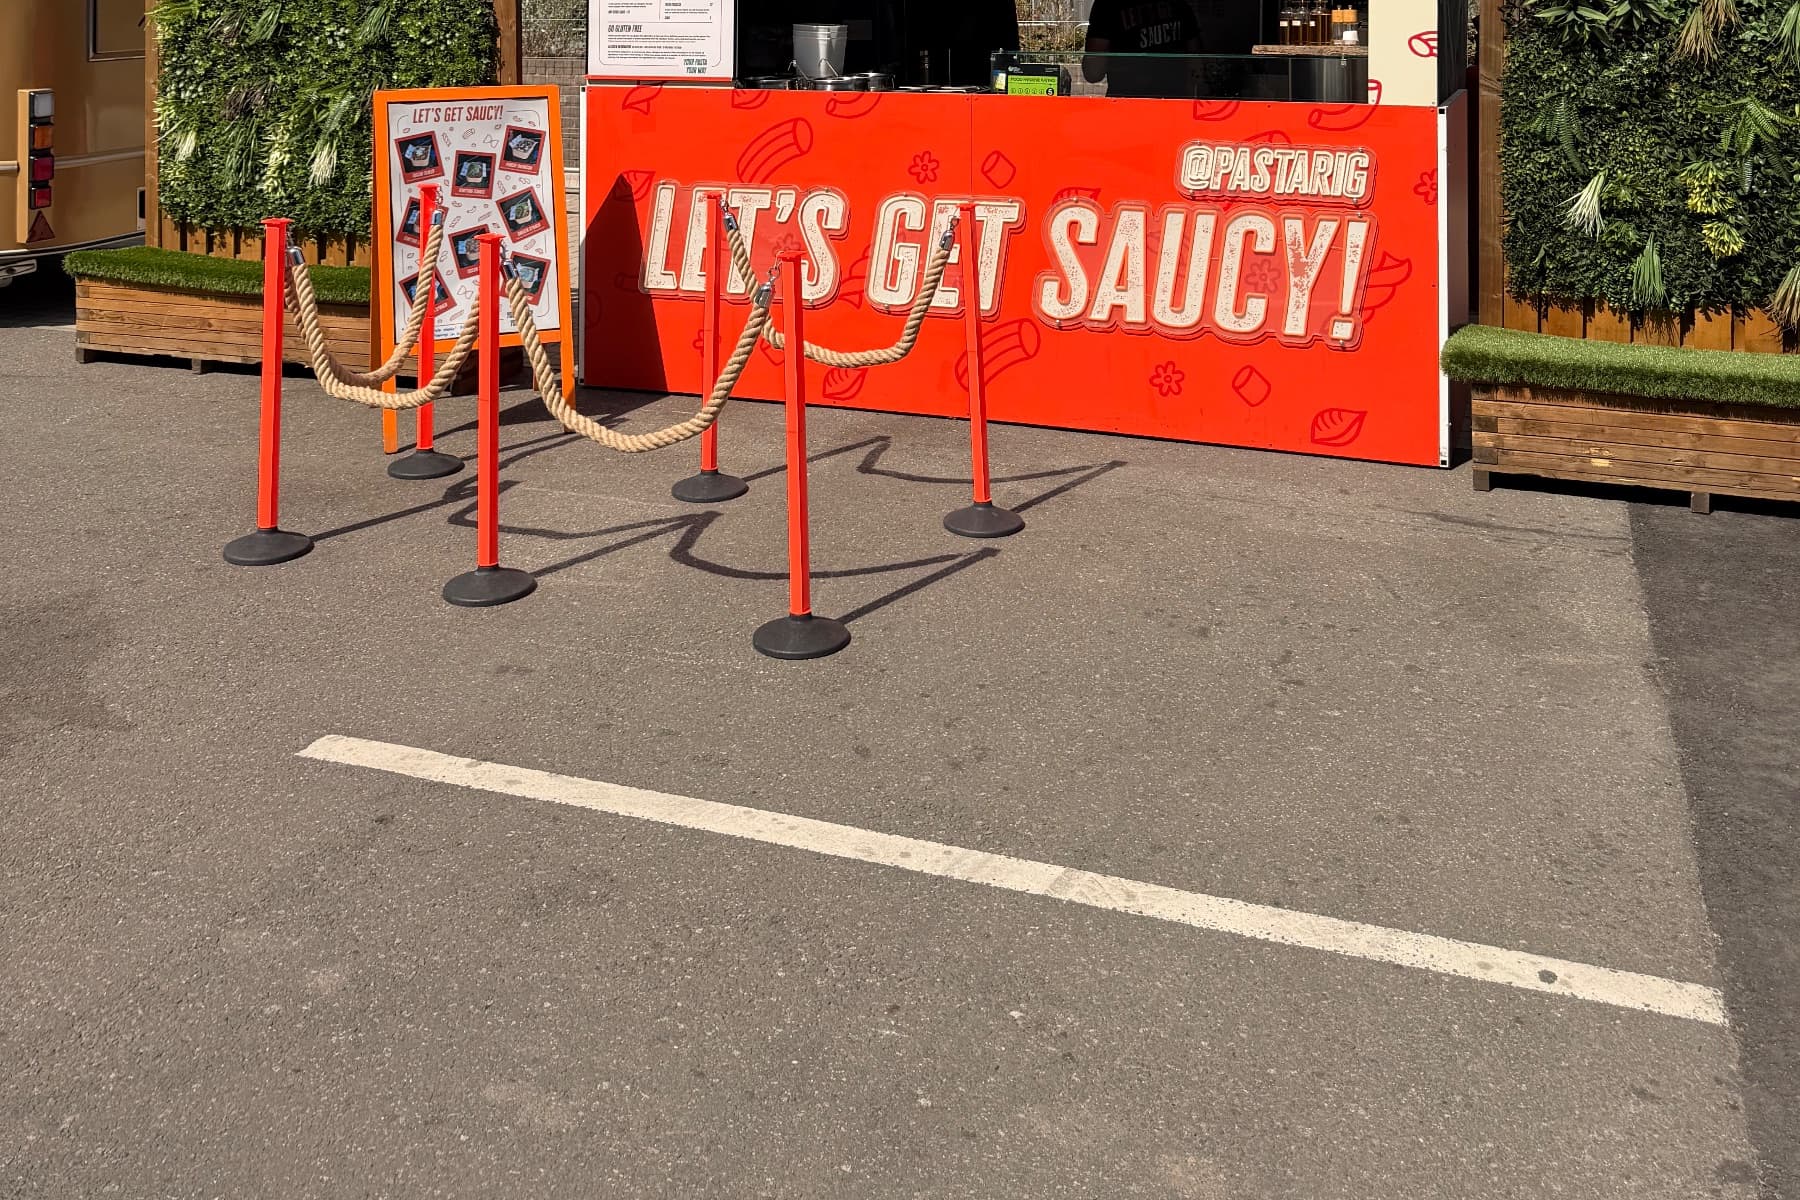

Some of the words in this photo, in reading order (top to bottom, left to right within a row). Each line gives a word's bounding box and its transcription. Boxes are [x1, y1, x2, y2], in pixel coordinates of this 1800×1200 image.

[412, 107, 441, 124] LET'S
[444, 107, 464, 122] GET
[466, 105, 504, 121] SAUCY!
[1180, 145, 1370, 198] @PASTARIG
[868, 195, 1020, 311] GET
[1040, 204, 1371, 340] SAUCY!
